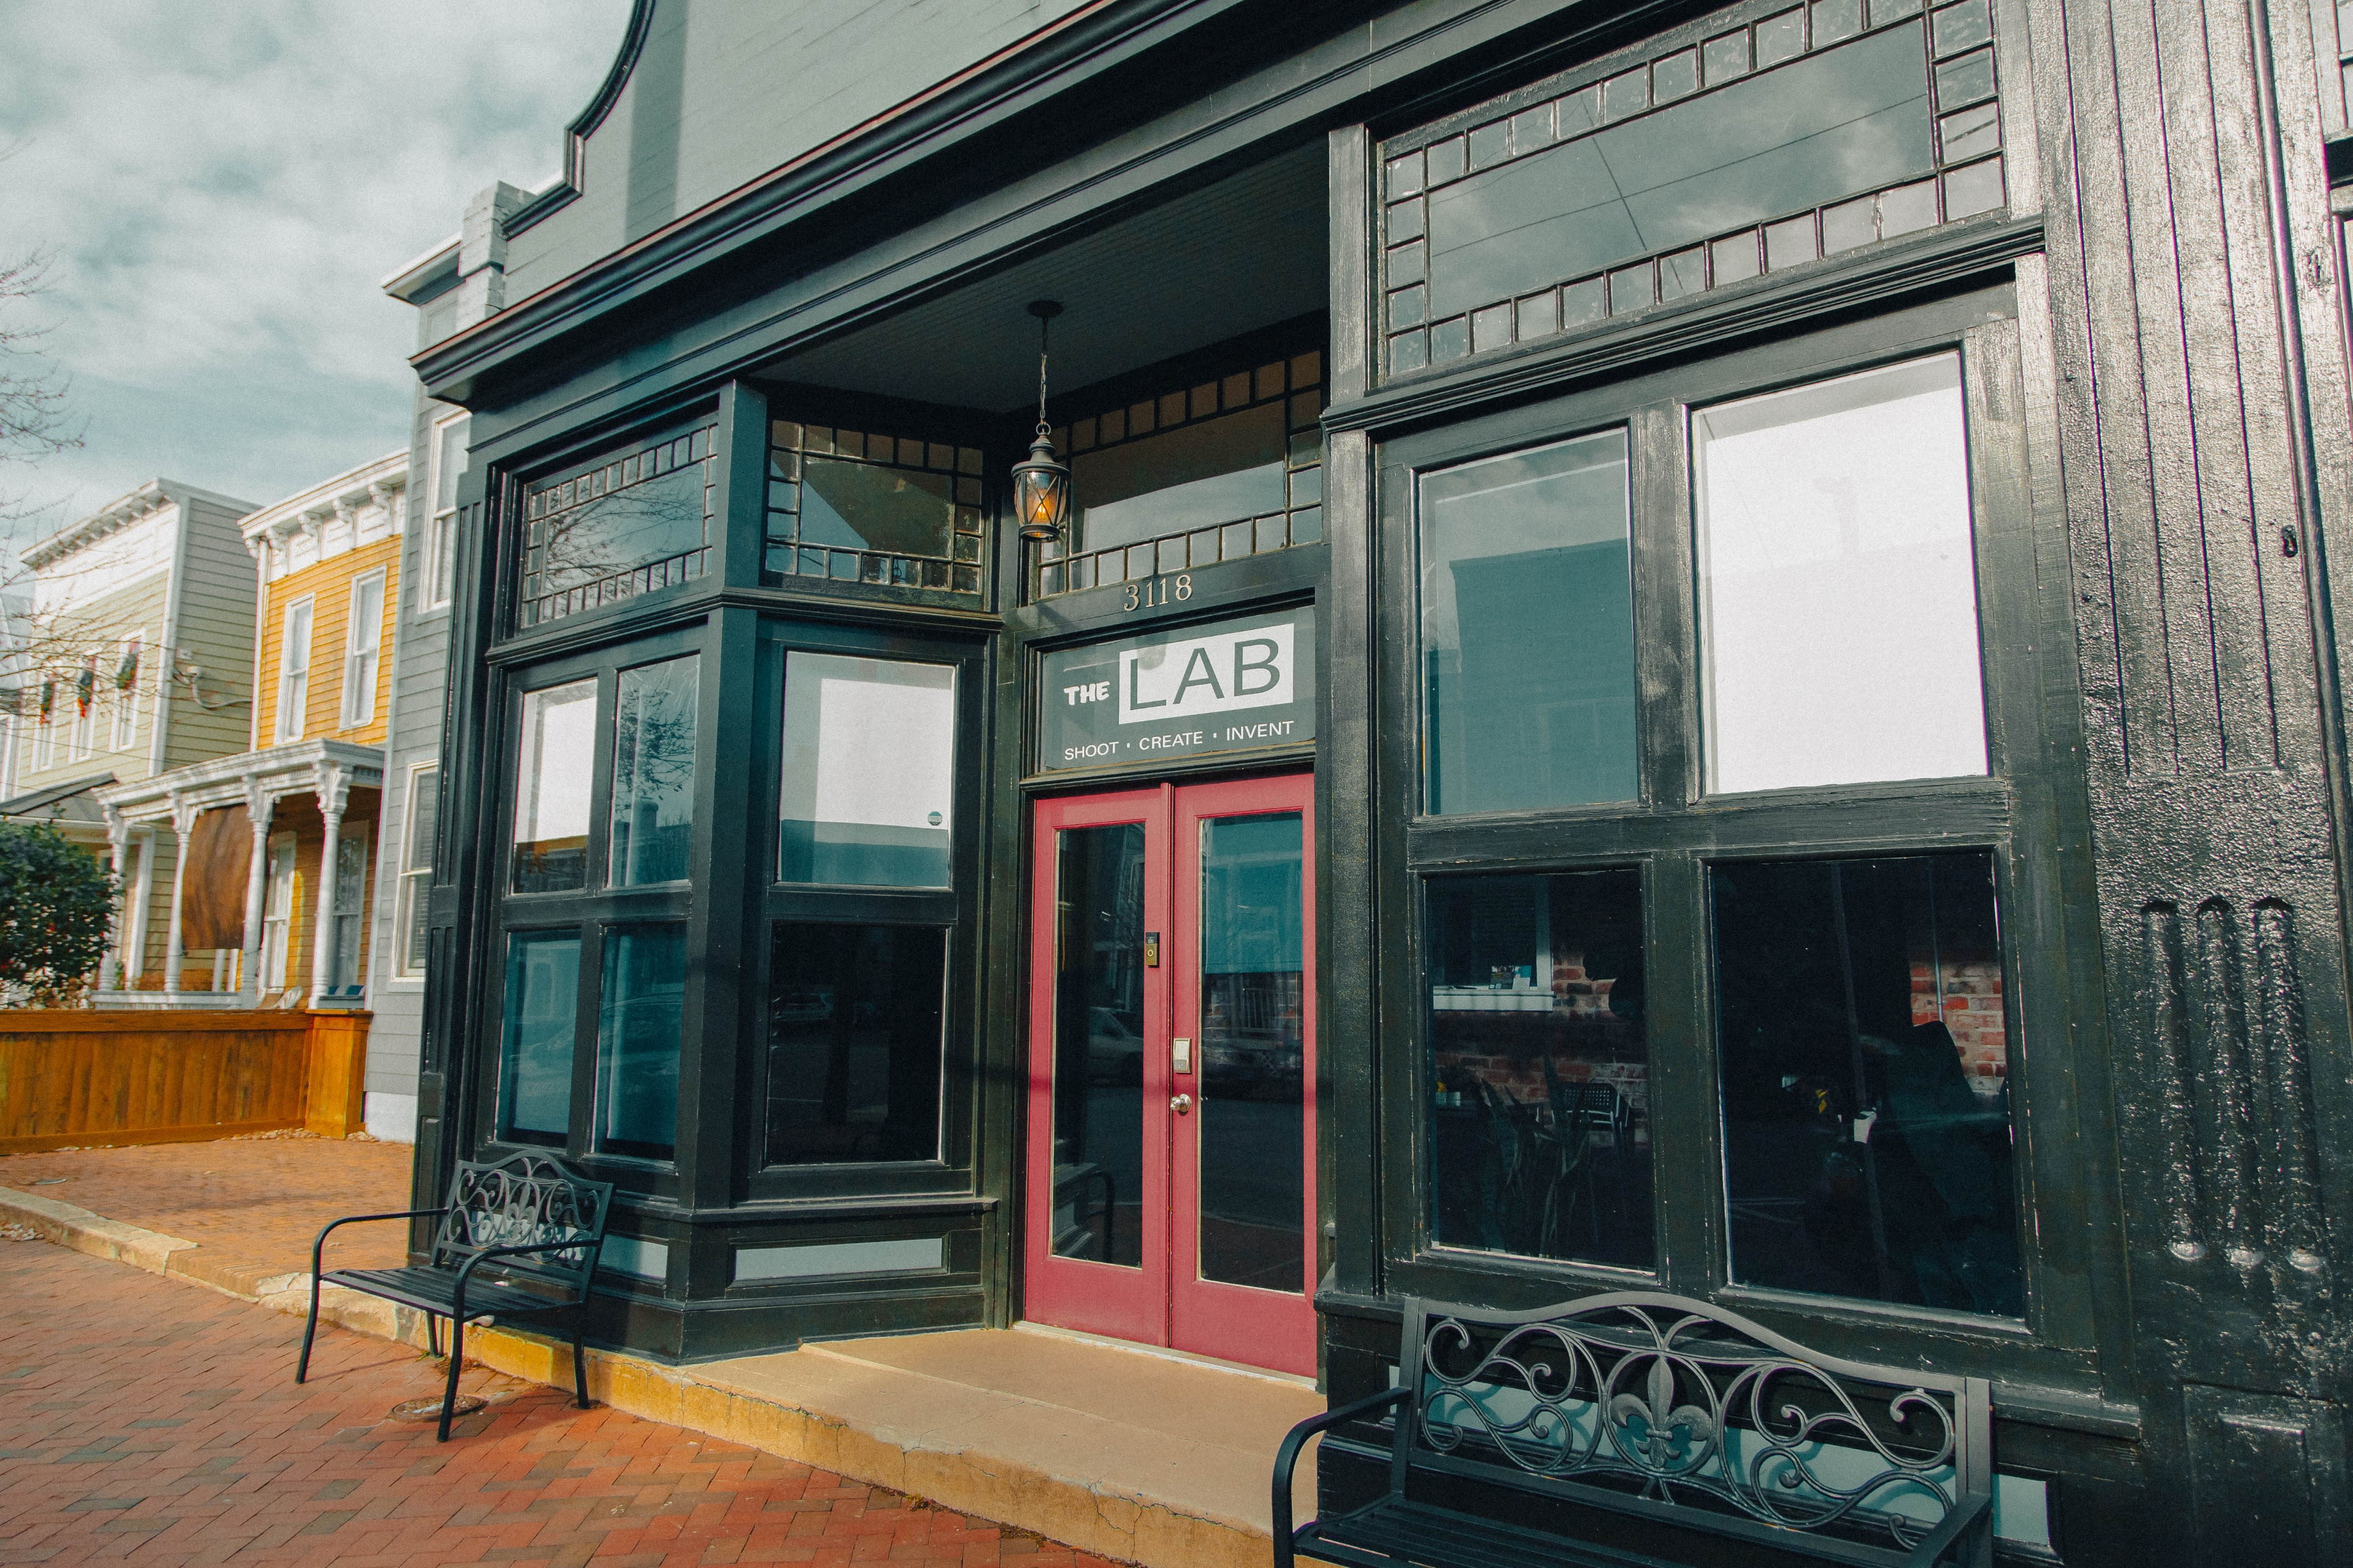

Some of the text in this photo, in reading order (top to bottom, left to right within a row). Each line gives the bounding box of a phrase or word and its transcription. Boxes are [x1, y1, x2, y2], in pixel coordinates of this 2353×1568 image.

[1124, 574, 1192, 611] 3118
[1064, 638, 1281, 710] THE LAB
[1064, 720, 1294, 760] SHOOT CREATE INVENT
